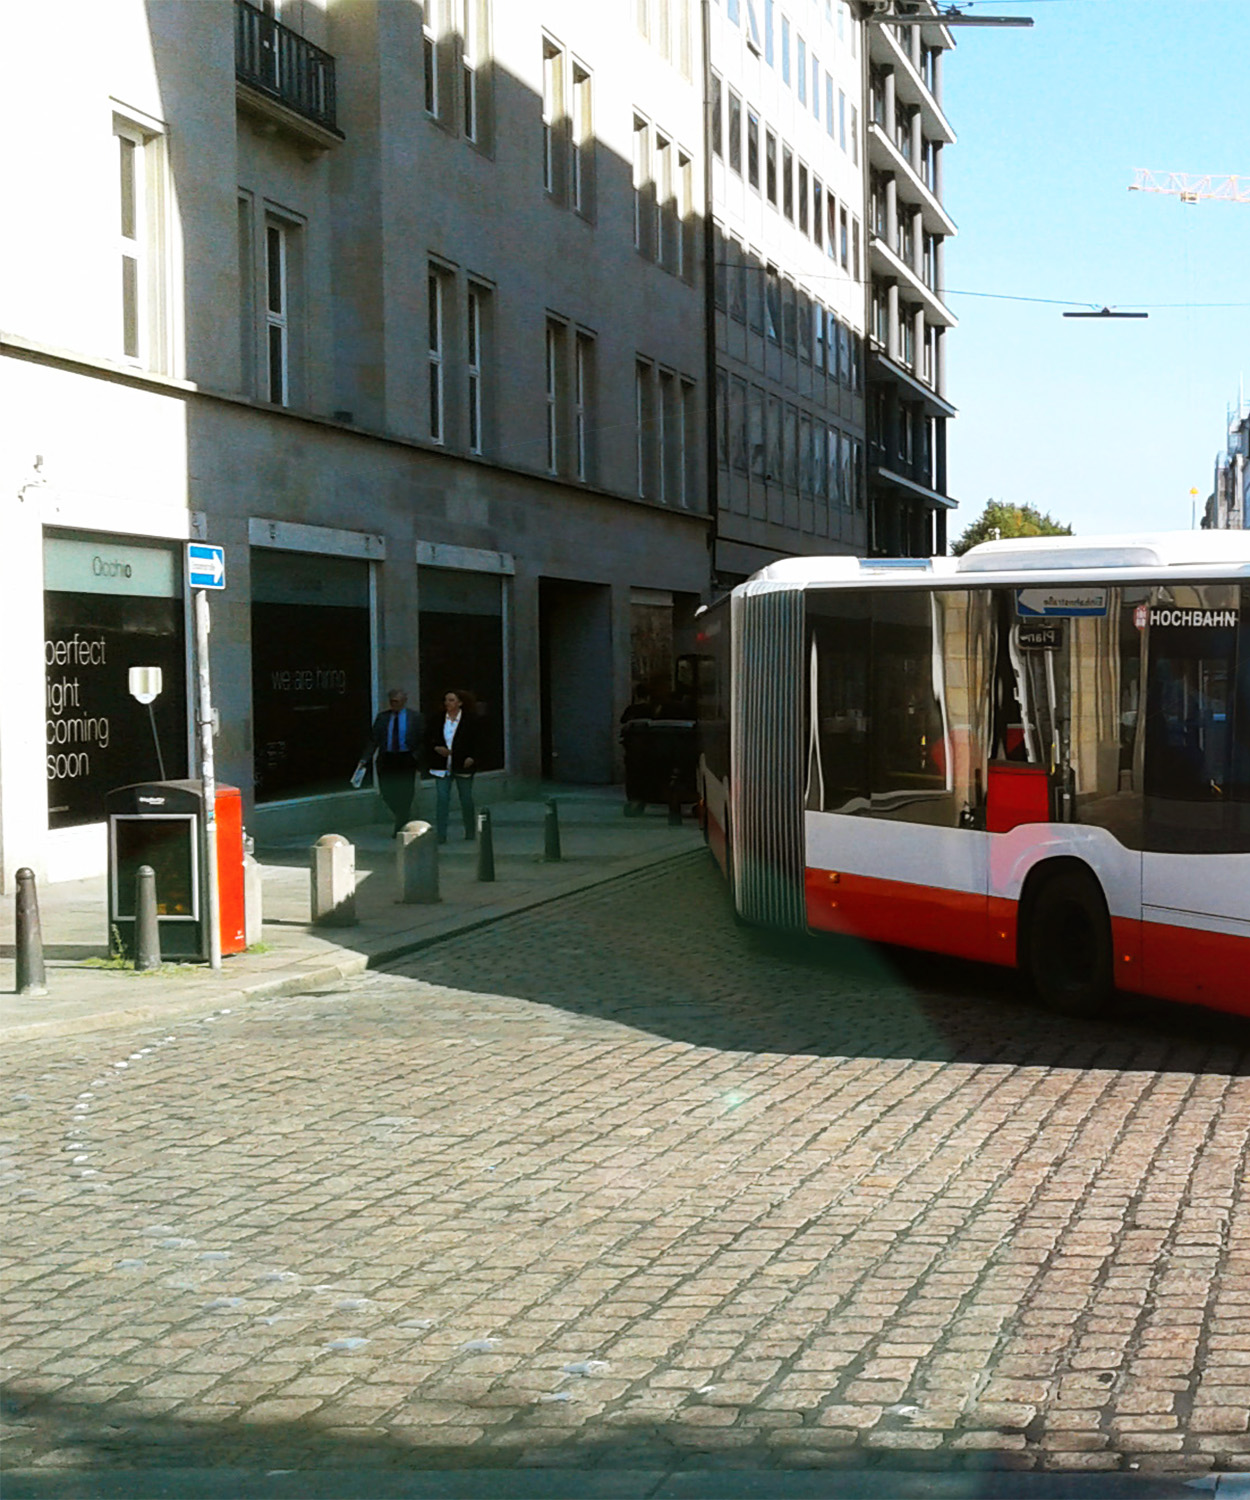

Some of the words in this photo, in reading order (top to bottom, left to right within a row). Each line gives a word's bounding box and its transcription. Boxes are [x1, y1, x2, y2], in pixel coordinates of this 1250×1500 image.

[1150, 610, 1236, 627] HOCHBAHN
[47, 676, 80, 715] ight
[46, 711, 109, 748] coming
[47, 753, 89, 779] soon
